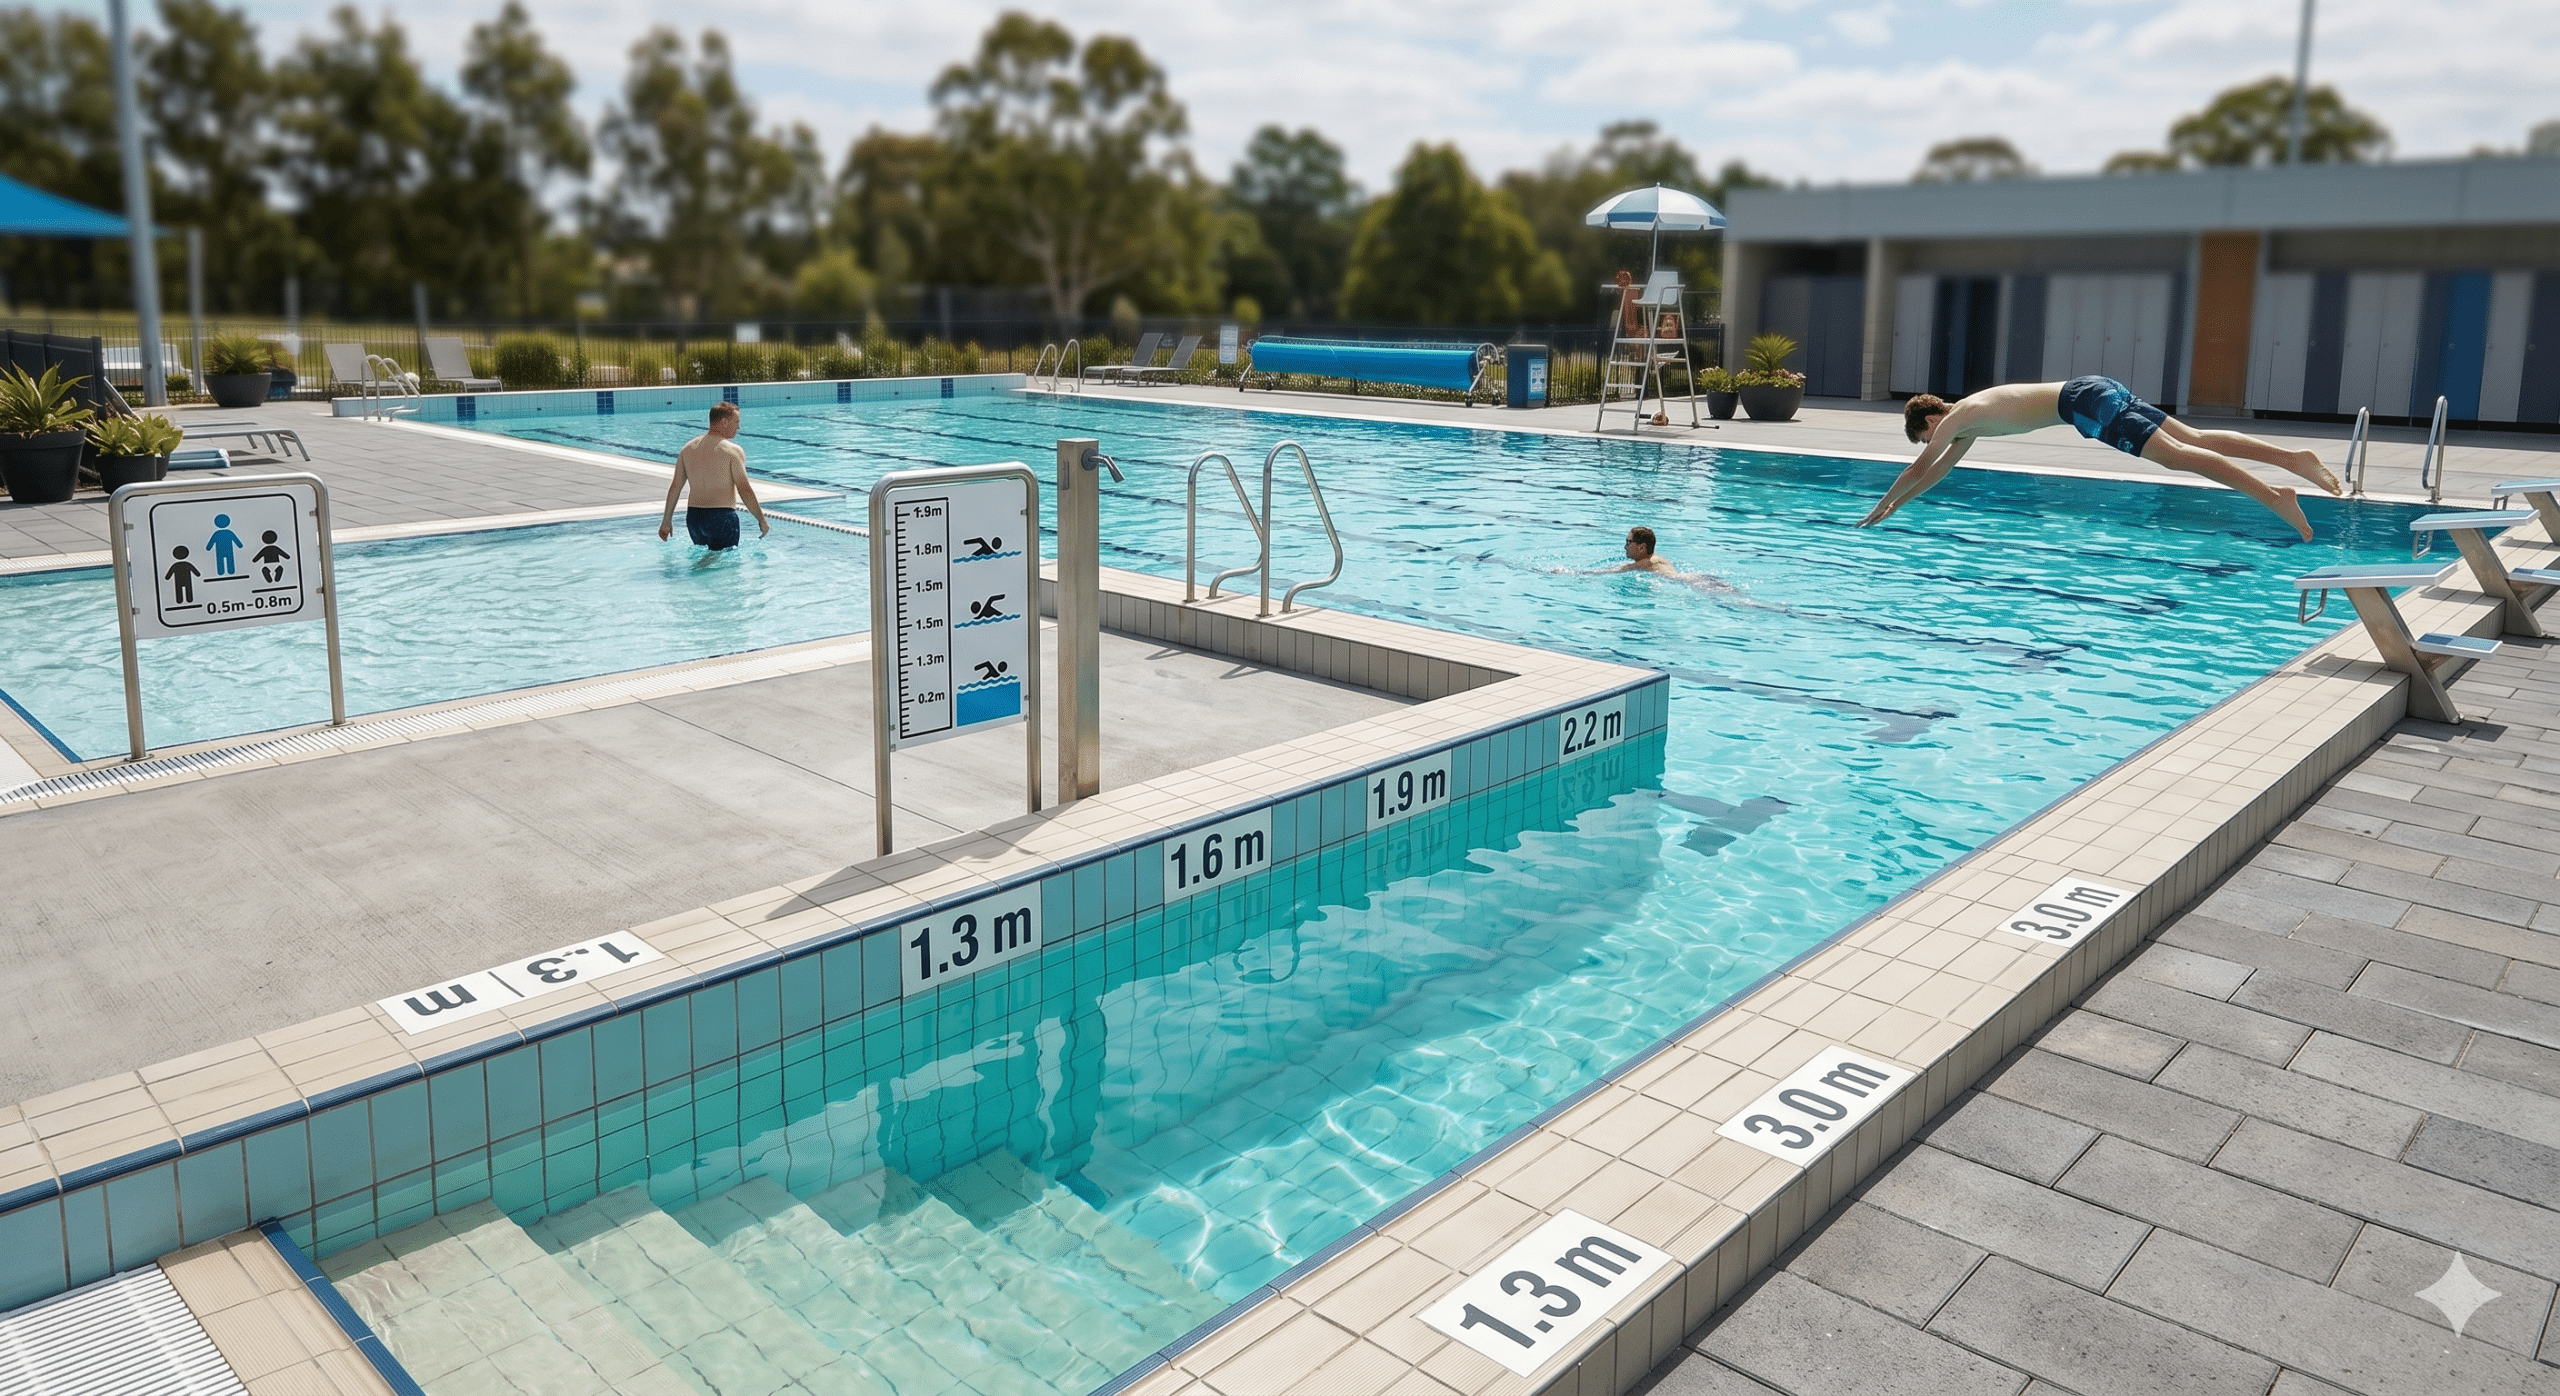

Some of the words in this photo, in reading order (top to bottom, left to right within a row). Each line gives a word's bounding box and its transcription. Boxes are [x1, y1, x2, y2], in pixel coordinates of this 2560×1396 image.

[914, 543, 943, 556] 1.8m
[915, 579, 943, 593] 1.5m
[916, 617, 944, 631] 1.5m
[916, 653, 944, 667] 1.3m
[918, 690, 945, 705] 0.2m
[1562, 710, 1598, 756] 2.2
[1602, 709, 1622, 742] m
[1372, 770, 1414, 820] 1.9
[1422, 768, 1446, 804] m
[1170, 833, 1223, 890] 1.6
[1234, 829, 1264, 870] m
[2010, 900, 2095, 942] 3.0
[2069, 884, 2121, 909] m
[910, 914, 979, 981] 1.3
[993, 906, 1032, 954] m
[403, 983, 478, 1017] m
[1742, 1087, 1841, 1151] 3.0
[1827, 1061, 1892, 1098] m
[1459, 1269, 1584, 1350] 1.3
[1554, 1234, 1643, 1290] m
